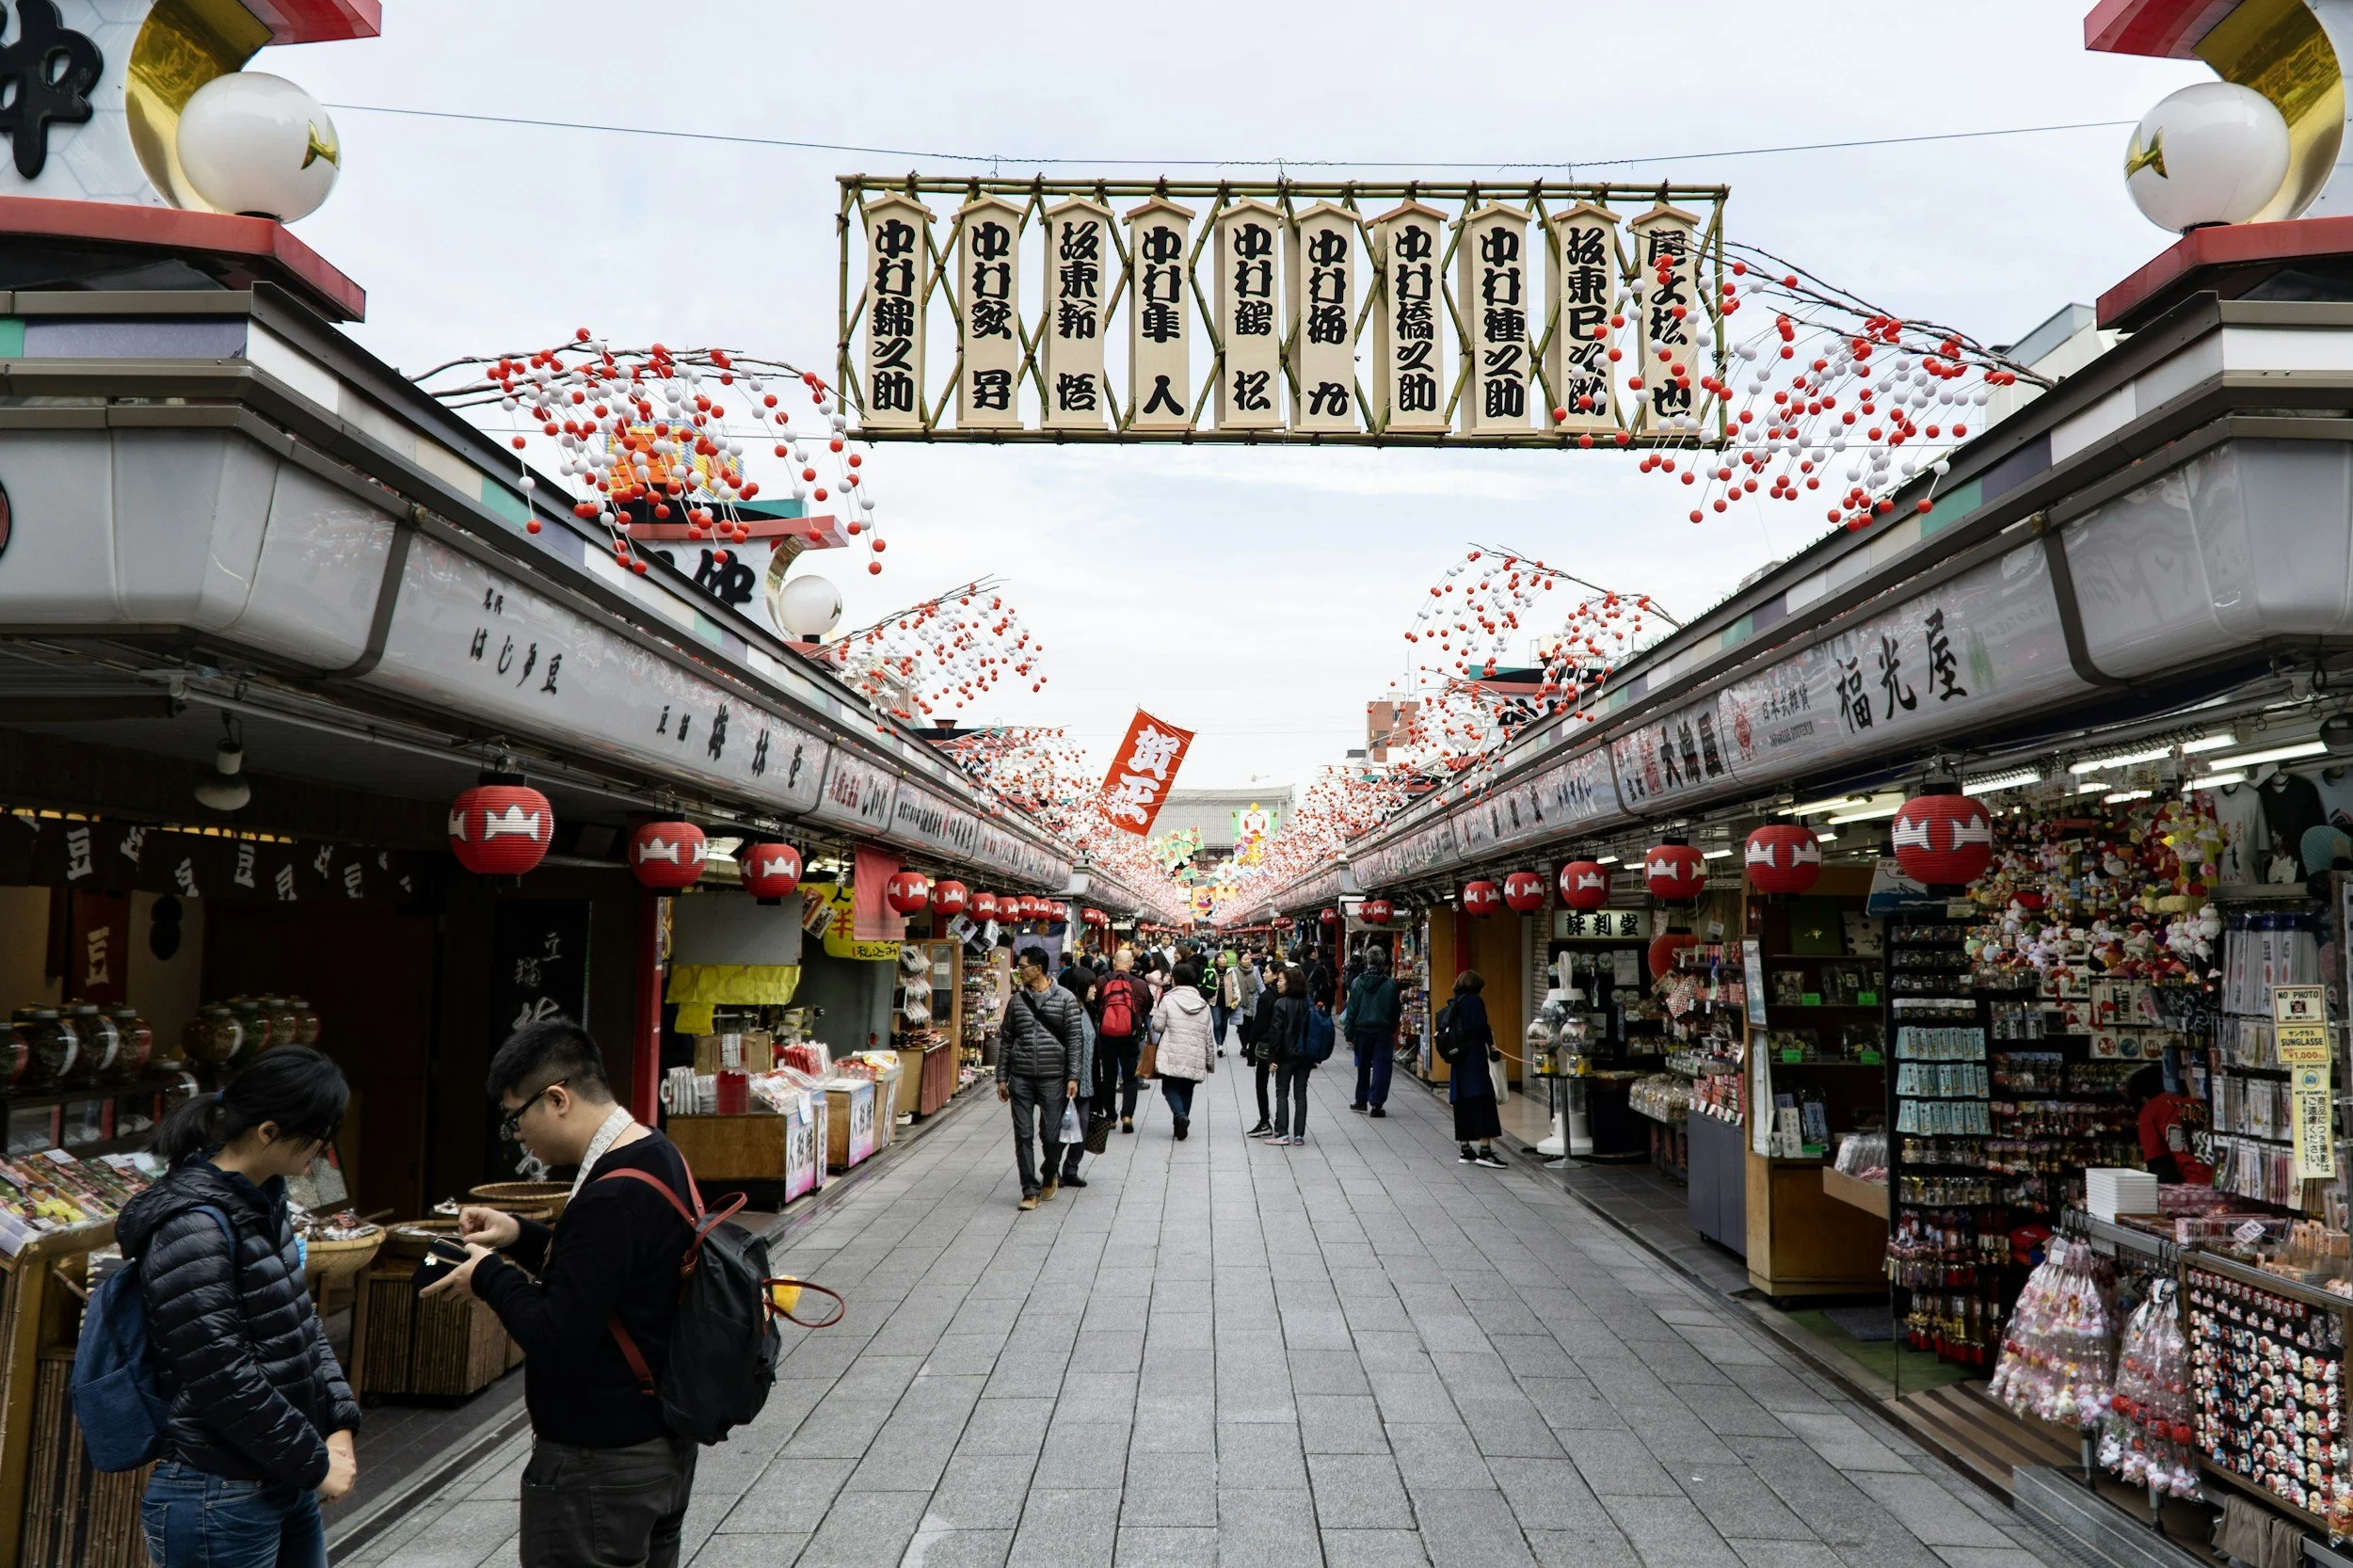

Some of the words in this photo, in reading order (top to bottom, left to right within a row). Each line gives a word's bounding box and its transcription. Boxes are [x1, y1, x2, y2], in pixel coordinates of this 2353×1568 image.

[872, 218, 916, 413] 中村錦之助
[970, 221, 1012, 411] 中村歌昇
[1056, 220, 1099, 412] 坂東新悟
[1142, 226, 1185, 416] 中村隼人
[1233, 223, 1273, 411] 中村鶴松
[1395, 225, 1437, 413] 中村橋之助
[1481, 226, 1526, 418] 中村種之助
[1836, 607, 1967, 734] 福光屋
[1566, 913, 1638, 936] 評判堂
